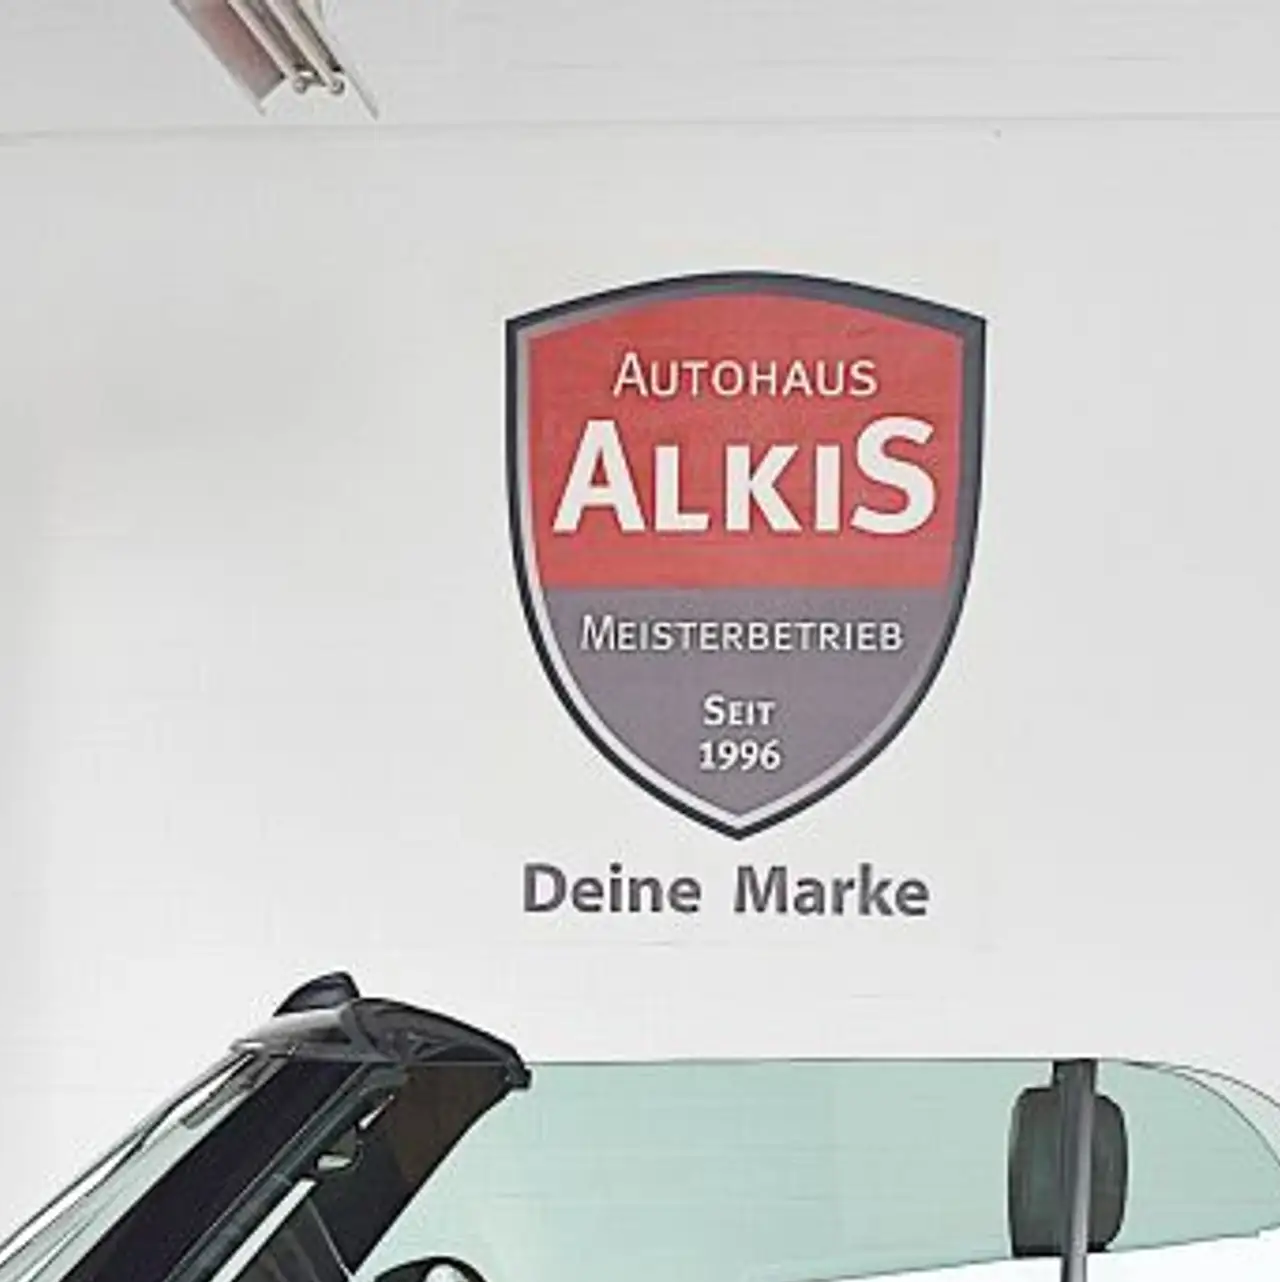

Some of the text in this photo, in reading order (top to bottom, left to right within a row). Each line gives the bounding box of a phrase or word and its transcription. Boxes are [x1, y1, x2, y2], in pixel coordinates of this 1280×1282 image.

[612, 352, 878, 397] AUTOHAUS
[552, 416, 937, 535] ALKIS
[581, 614, 903, 651] MEISTERBETRIEB
[703, 695, 775, 727] SEIT
[700, 739, 781, 771] 1996
[523, 862, 930, 917] Deine Marke
